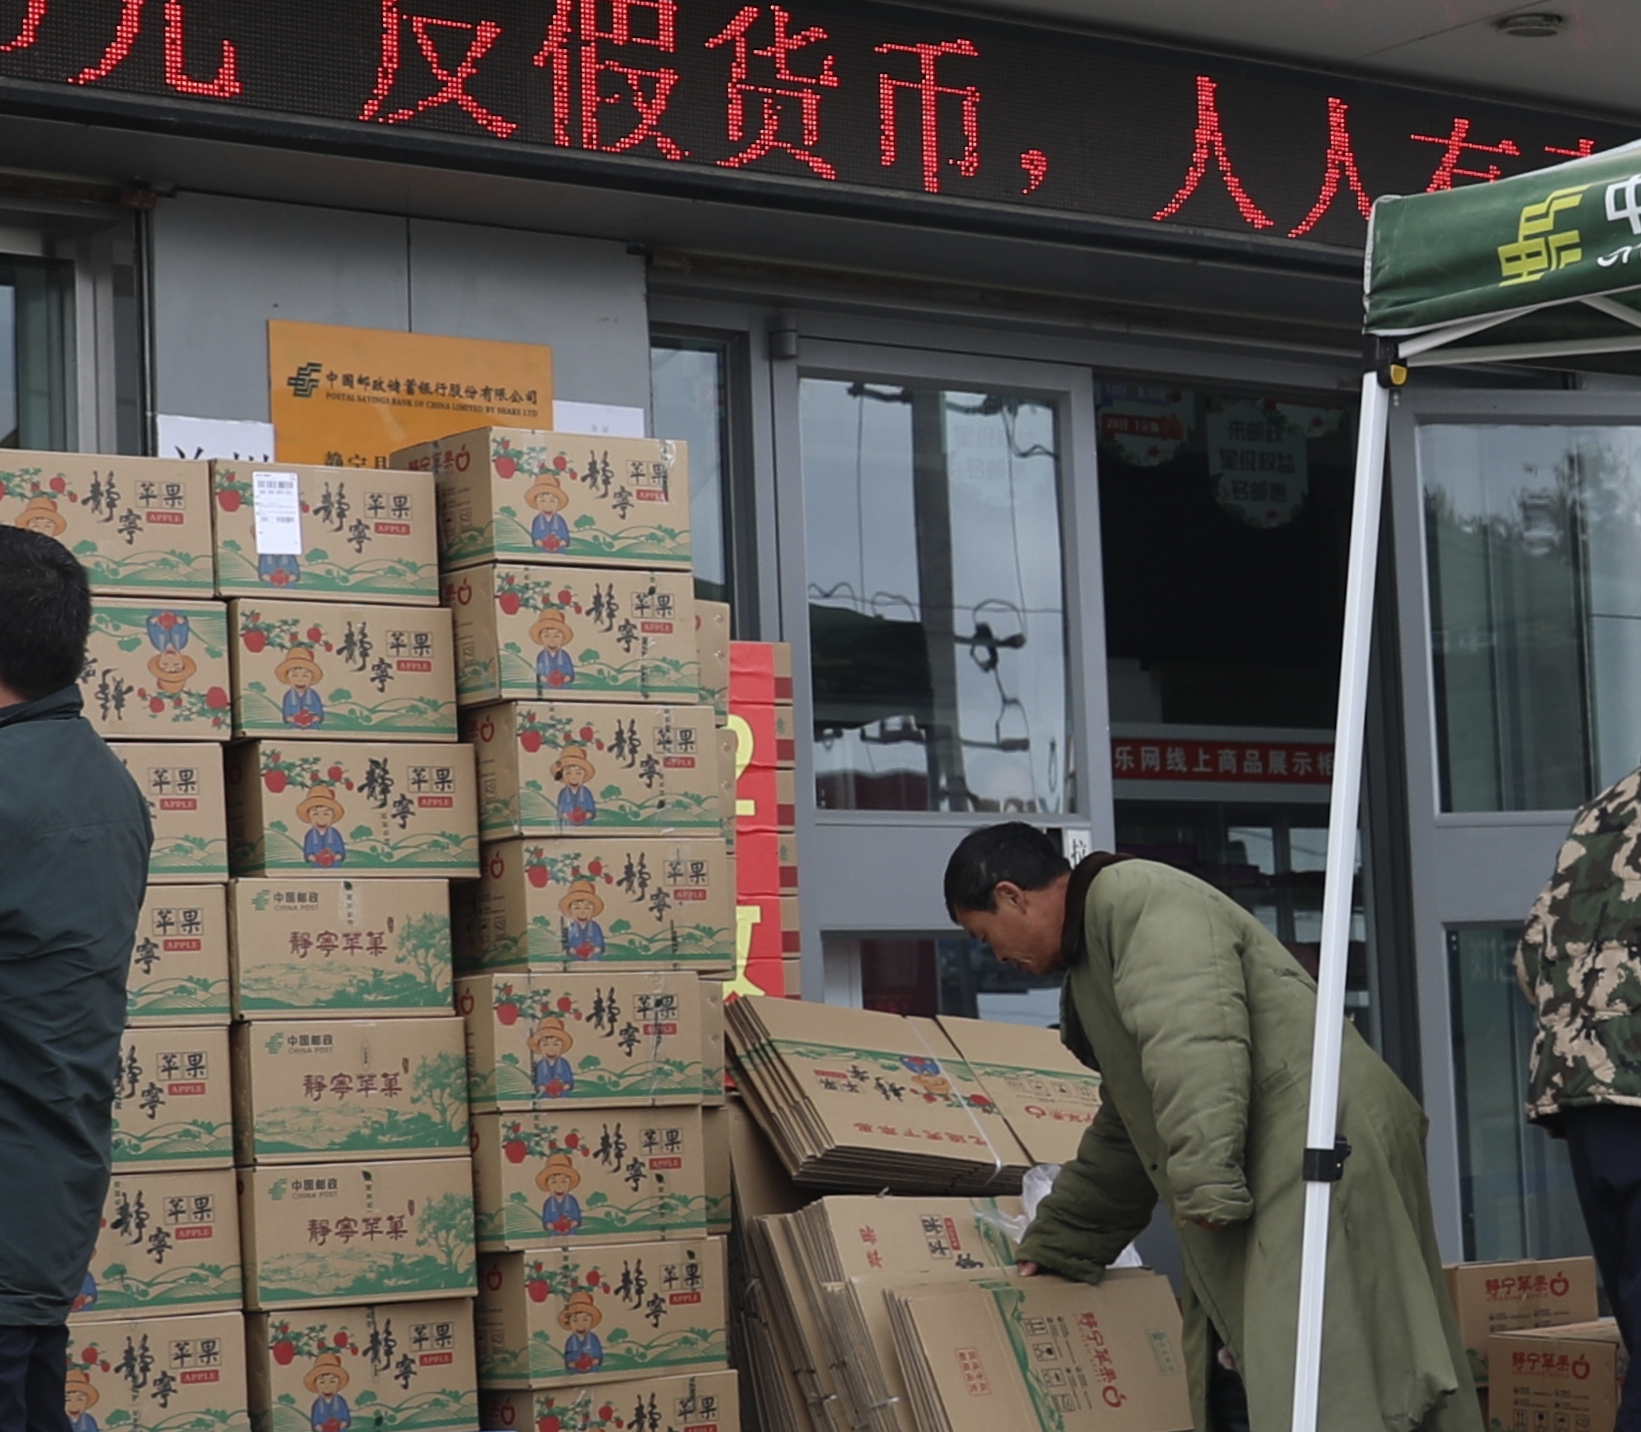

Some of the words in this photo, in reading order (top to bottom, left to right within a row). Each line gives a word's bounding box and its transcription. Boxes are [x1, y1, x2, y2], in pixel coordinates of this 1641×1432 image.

[325, 371, 539, 406] 中国邮政储蓄银行股份有限公司
[273, 891, 319, 904] 中国邮政
[287, 1033, 334, 1047] 中国邮政
[291, 1178, 339, 1192] 中国邮政
[1484, 1274, 1549, 1297] 静宁苹果
